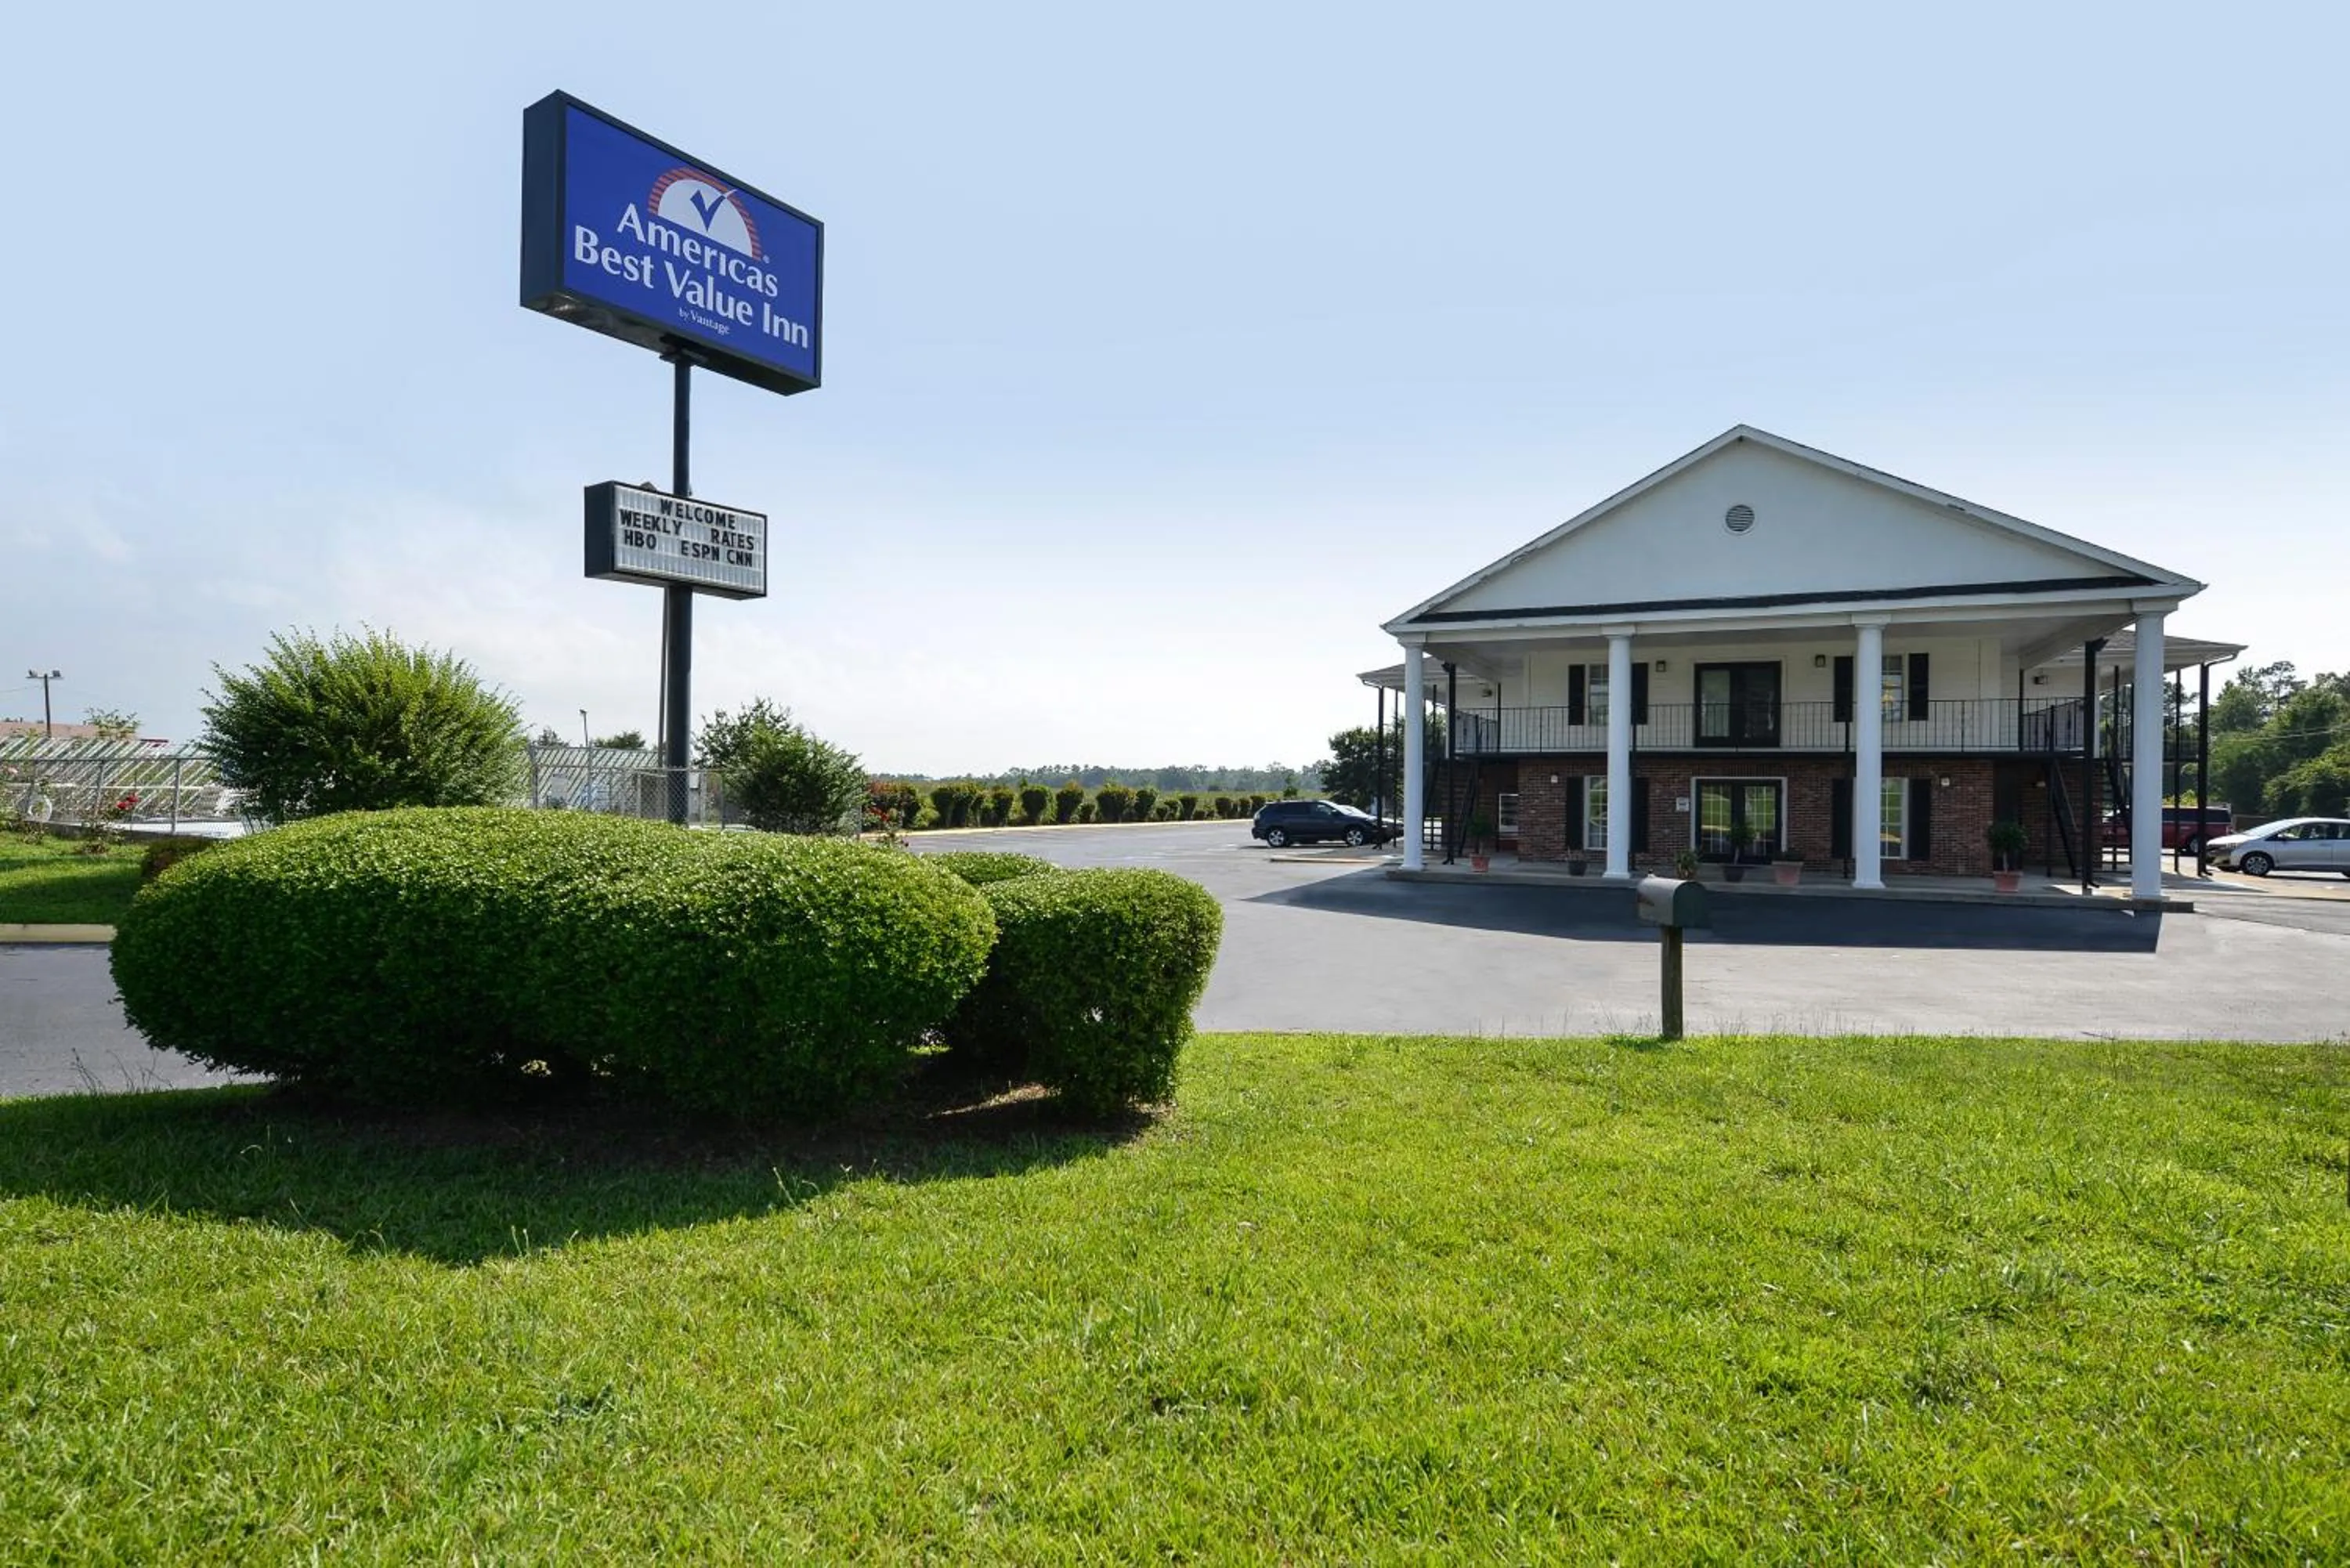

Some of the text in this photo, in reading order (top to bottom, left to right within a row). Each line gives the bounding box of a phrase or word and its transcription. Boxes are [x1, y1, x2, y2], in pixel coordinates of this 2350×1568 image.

[616, 202, 779, 298] Americas
[573, 225, 808, 349] Best Value Inn
[679, 306, 731, 336] by Vantage
[620, 510, 754, 551] WEEKLY RATES
[660, 499, 736, 529] WELCOME
[624, 529, 753, 568] HBO ESPN CNN
